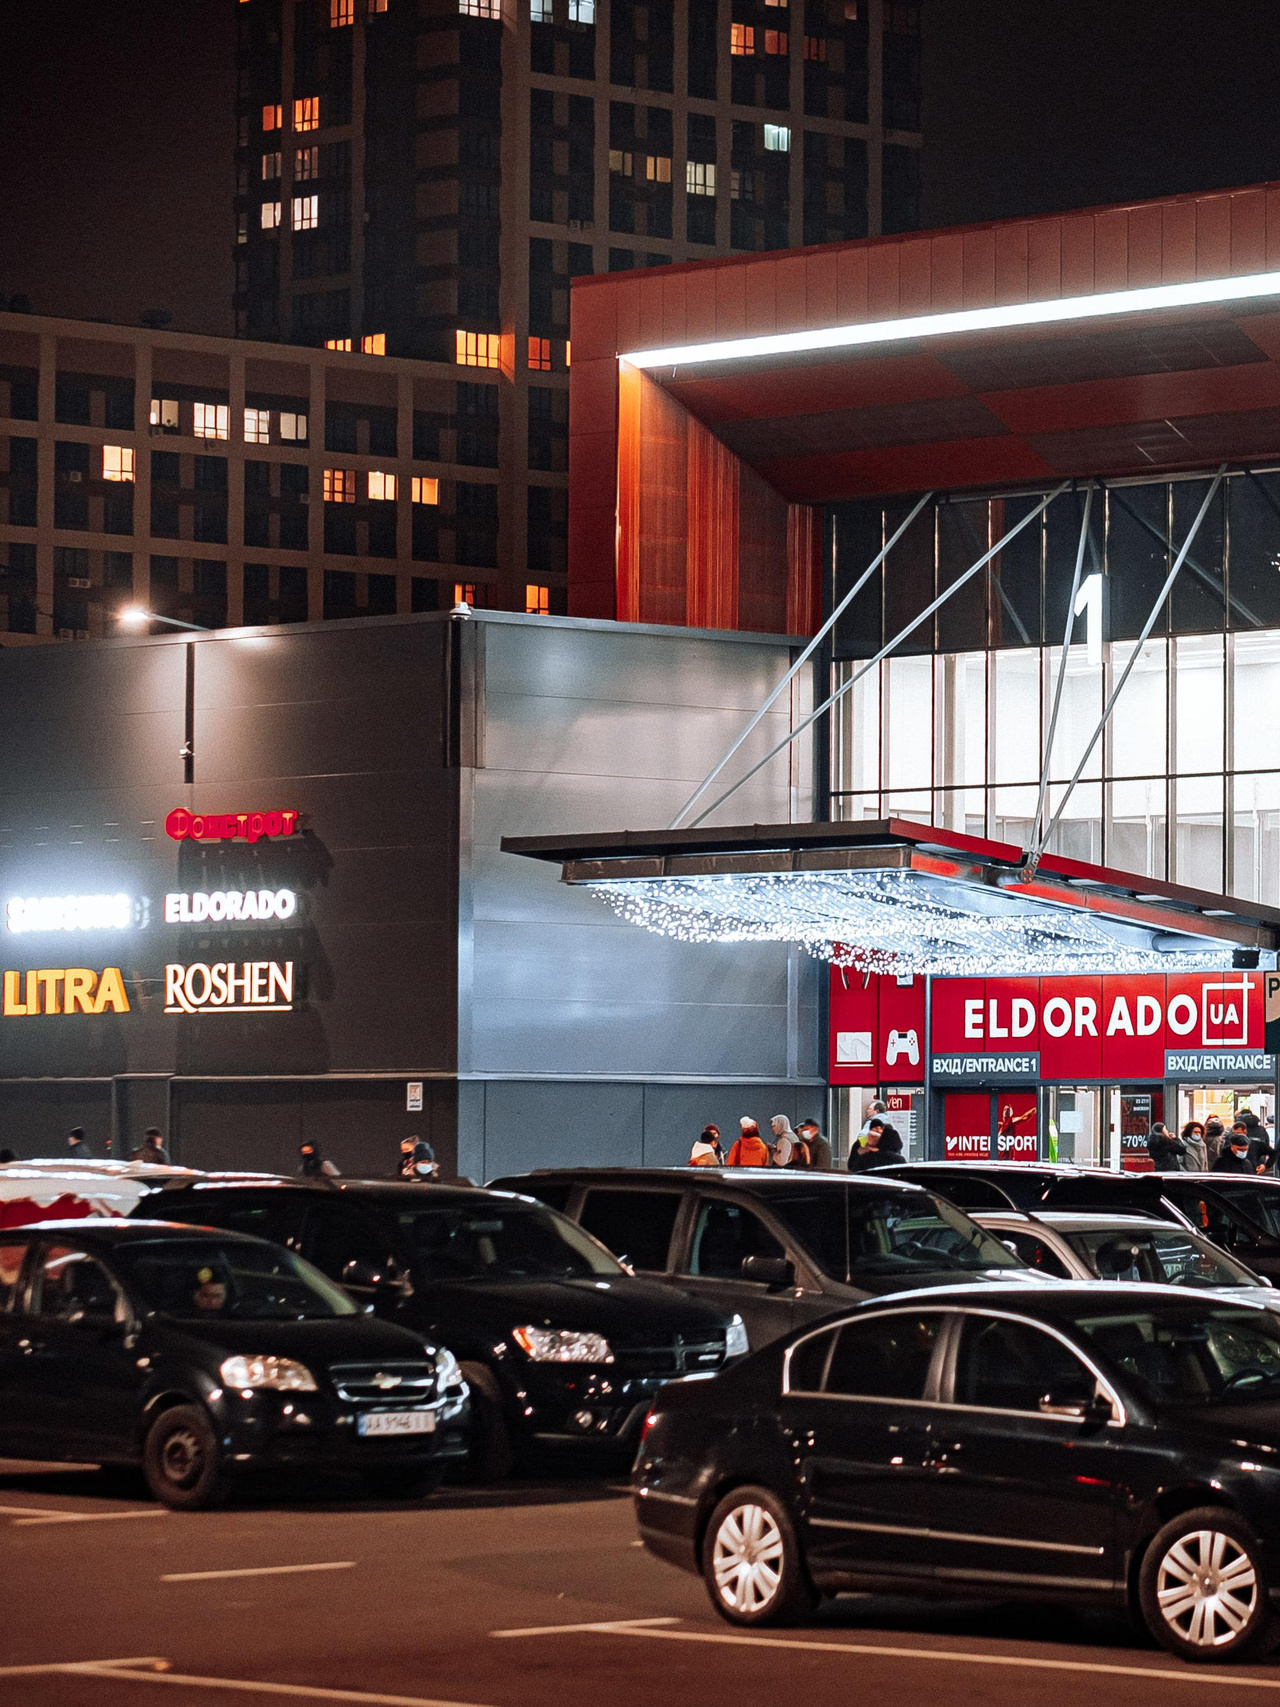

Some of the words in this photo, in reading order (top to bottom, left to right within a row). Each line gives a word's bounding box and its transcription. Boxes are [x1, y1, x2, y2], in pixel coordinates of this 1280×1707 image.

[1074, 573, 1103, 665] 1
[164, 889, 296, 923] ELDORADO
[3, 967, 130, 1016] LITRA
[164, 961, 294, 1013] ROSHEN
[964, 993, 1199, 1038] ELDORADO
[1209, 1003, 1239, 1025] UA
